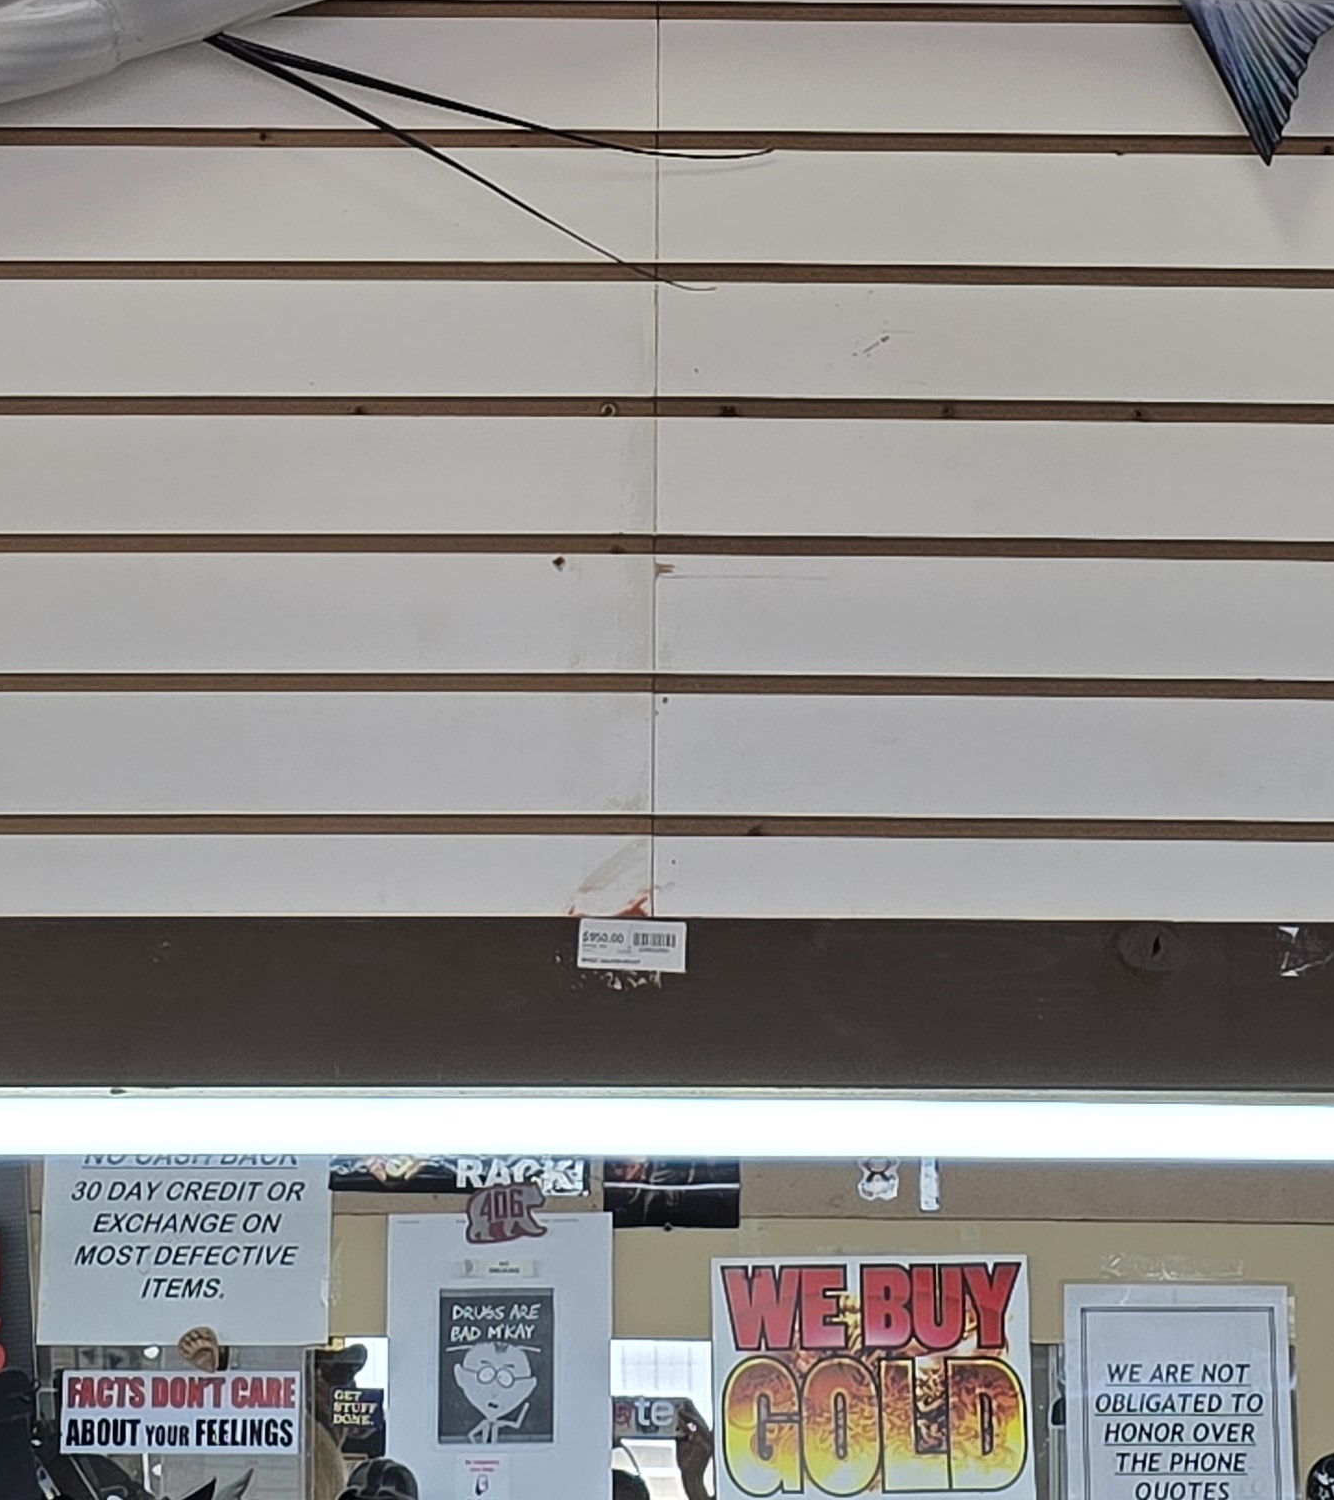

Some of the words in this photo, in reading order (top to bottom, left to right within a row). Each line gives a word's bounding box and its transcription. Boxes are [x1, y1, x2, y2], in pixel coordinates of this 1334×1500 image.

[71, 1180, 103, 1201] 30
[107, 1180, 164, 1201] DAY
[165, 1180, 264, 1201] CREDIT
[266, 1180, 306, 1201] OR
[479, 1188, 525, 1221] 406
[92, 1212, 238, 1234] EXCHANGE
[242, 1212, 283, 1234] ON
[73, 1244, 151, 1266] MOST
[153, 1245, 299, 1266] DEFECTIVE
[140, 1277, 226, 1300] ITEMS.
[451, 1303, 505, 1321] DRUGS
[509, 1302, 542, 1320] ARE
[720, 1263, 848, 1352] WE
[859, 1262, 1022, 1351] BUY
[450, 1325, 482, 1342] BAD
[1106, 1363, 1143, 1383] WE
[1149, 1363, 1195, 1383] ARE
[1201, 1363, 1251, 1383] NOT
[67, 1376, 146, 1410] FACTS
[151, 1376, 226, 1410] DON'T
[230, 1376, 296, 1410] CARE
[1095, 1392, 1223, 1413] OBLIGATED
[1232, 1393, 1264, 1413] TO
[65, 1418, 142, 1447] ABOUT
[145, 1424, 190, 1447] YOUR
[195, 1418, 294, 1448] FEELINGS
[722, 1355, 1029, 1499] GOLD
[1104, 1422, 1185, 1443] HONOR
[1193, 1422, 1256, 1443] OVER
[1116, 1452, 1163, 1472] THE
[1169, 1452, 1248, 1473] PHONE
[1135, 1482, 1230, 1500] QUOTES
